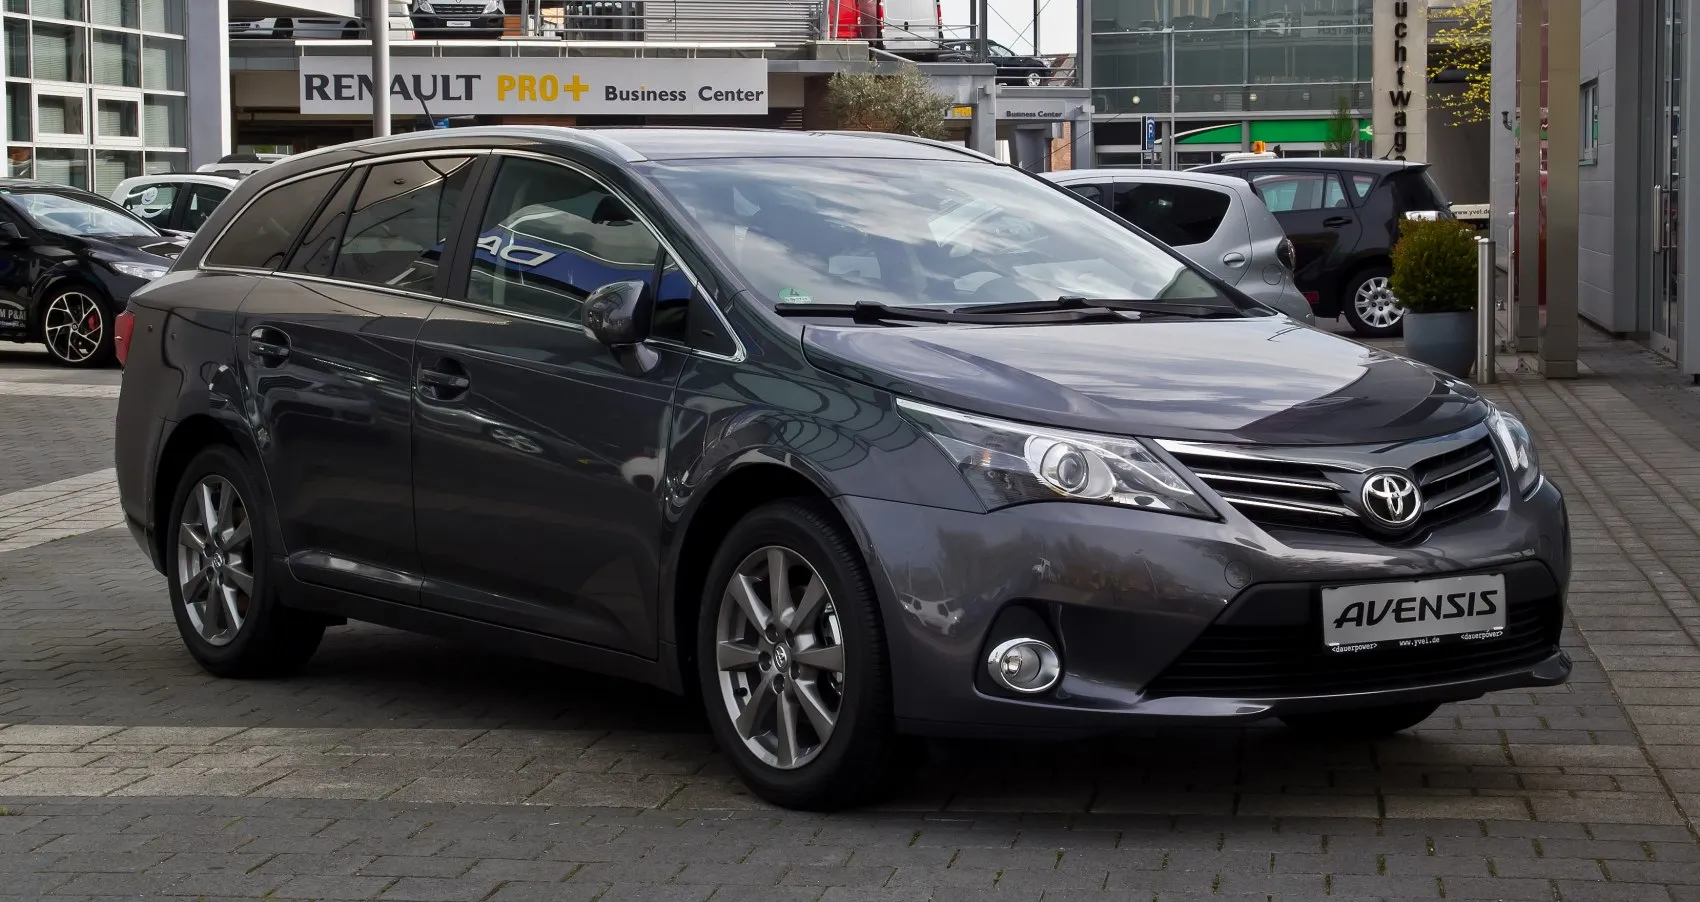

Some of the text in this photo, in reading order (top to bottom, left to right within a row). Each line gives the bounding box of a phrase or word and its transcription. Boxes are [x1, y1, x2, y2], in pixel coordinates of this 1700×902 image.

[604, 85, 687, 102] Business
[697, 85, 764, 102] Center
[1006, 110, 1063, 118] Business Center
[1333, 589, 1498, 629] AVENSIS
